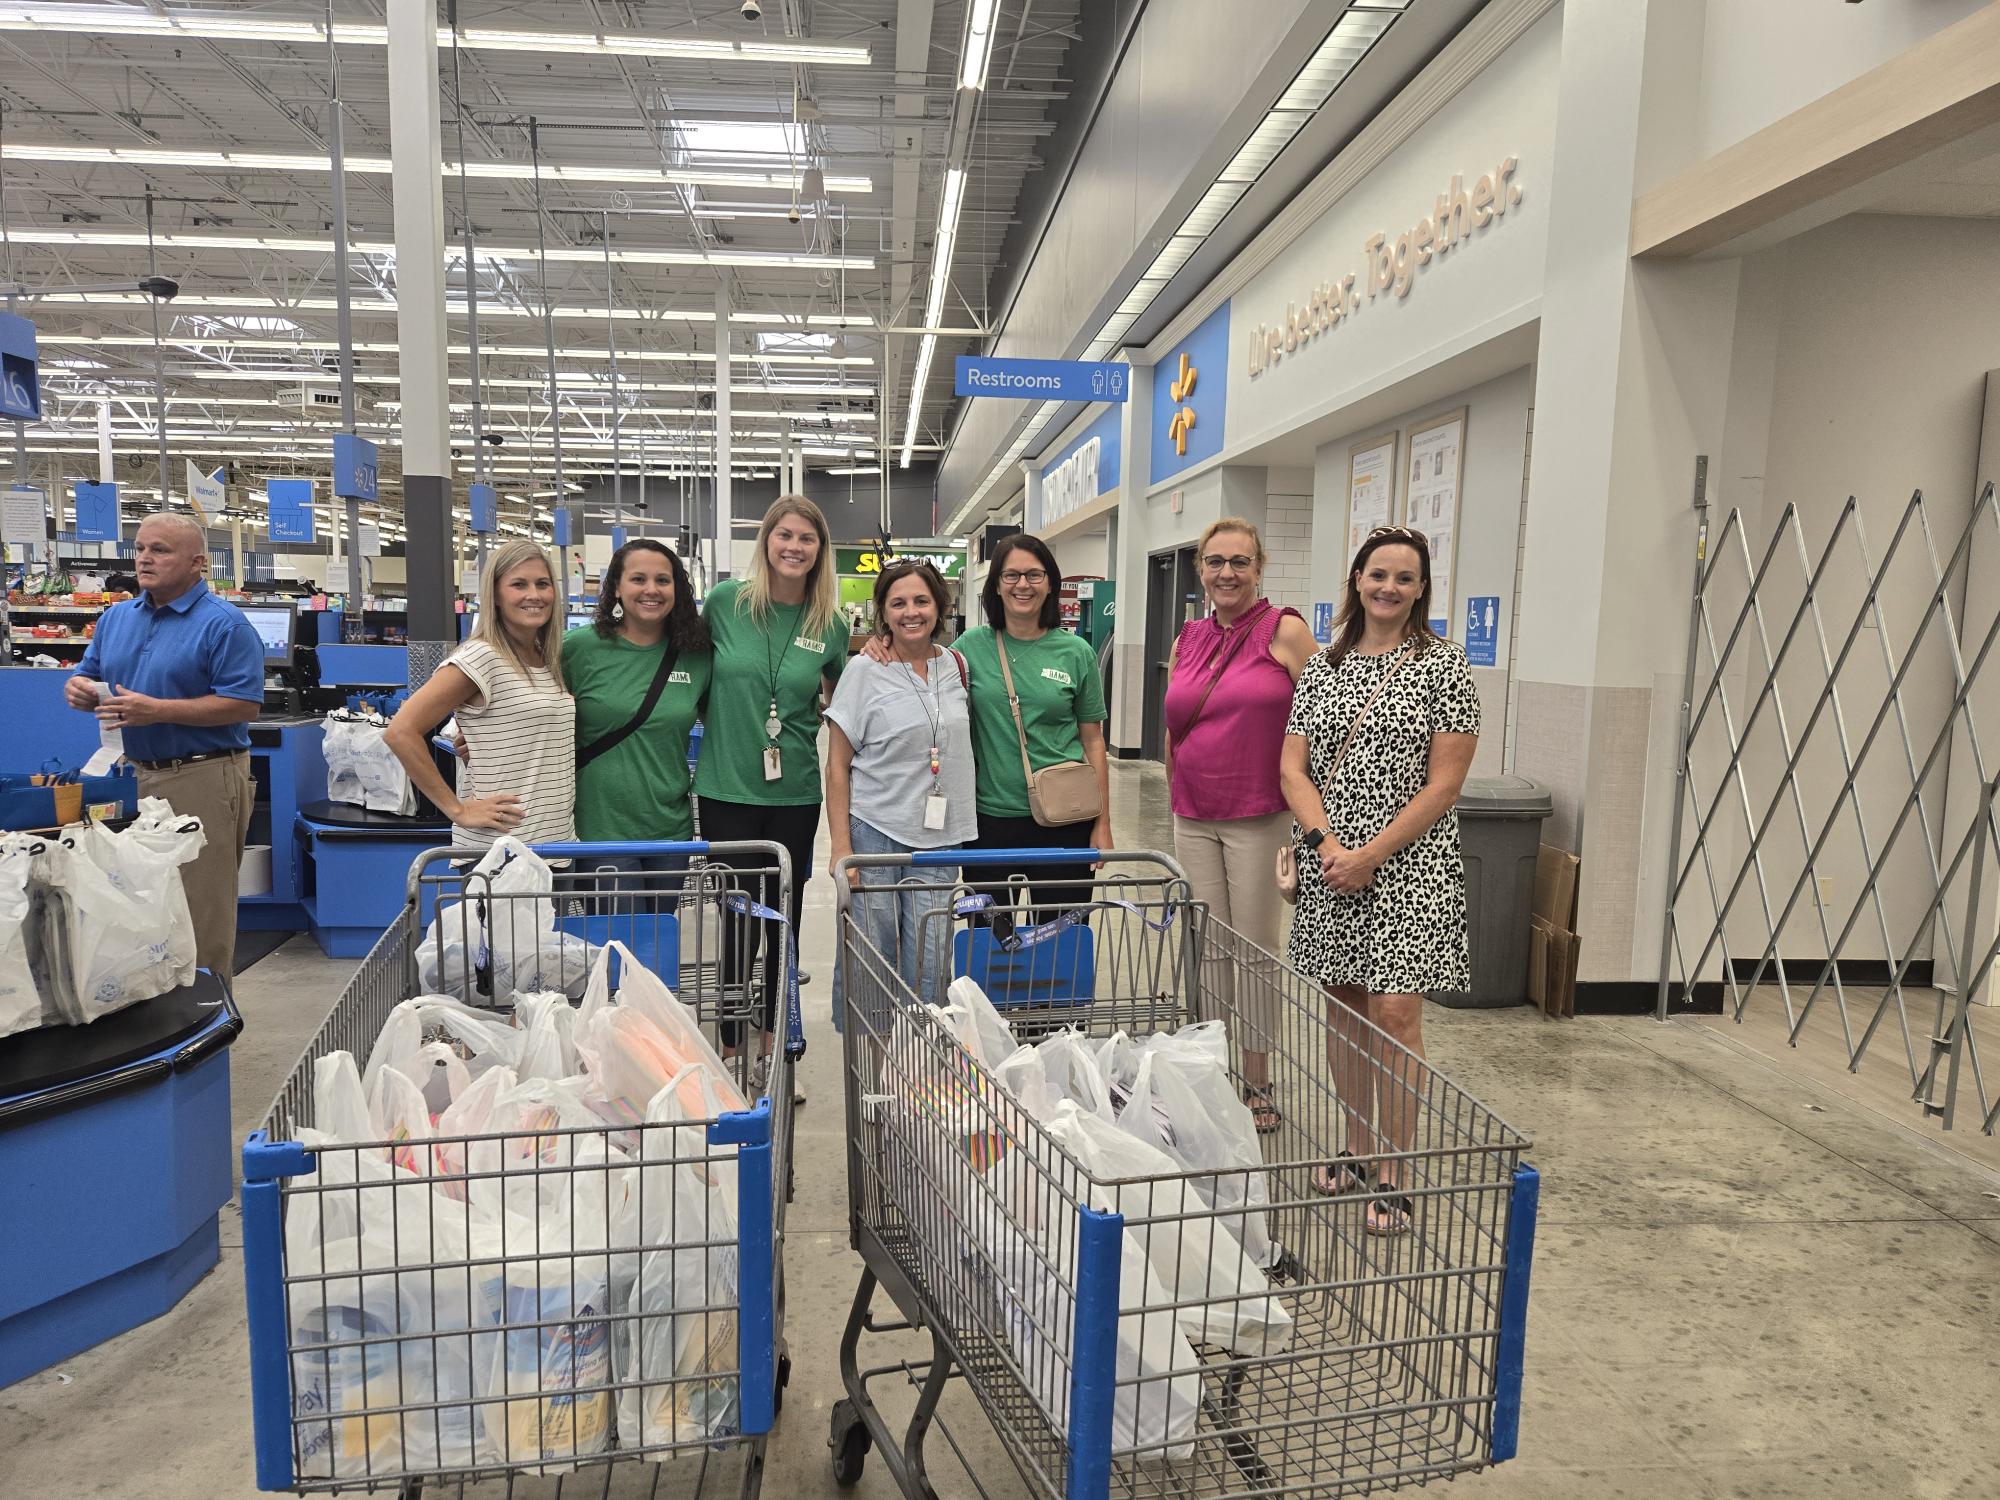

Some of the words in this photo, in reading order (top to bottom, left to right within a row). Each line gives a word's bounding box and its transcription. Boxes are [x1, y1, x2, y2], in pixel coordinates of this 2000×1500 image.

[1285, 271, 1361, 353] better.
[1364, 155, 1524, 299] Together.
[967, 368, 1062, 390] Restrooms
[362, 467, 376, 492] 24
[274, 521, 287, 529] Self
[274, 529, 304, 537] Checkout
